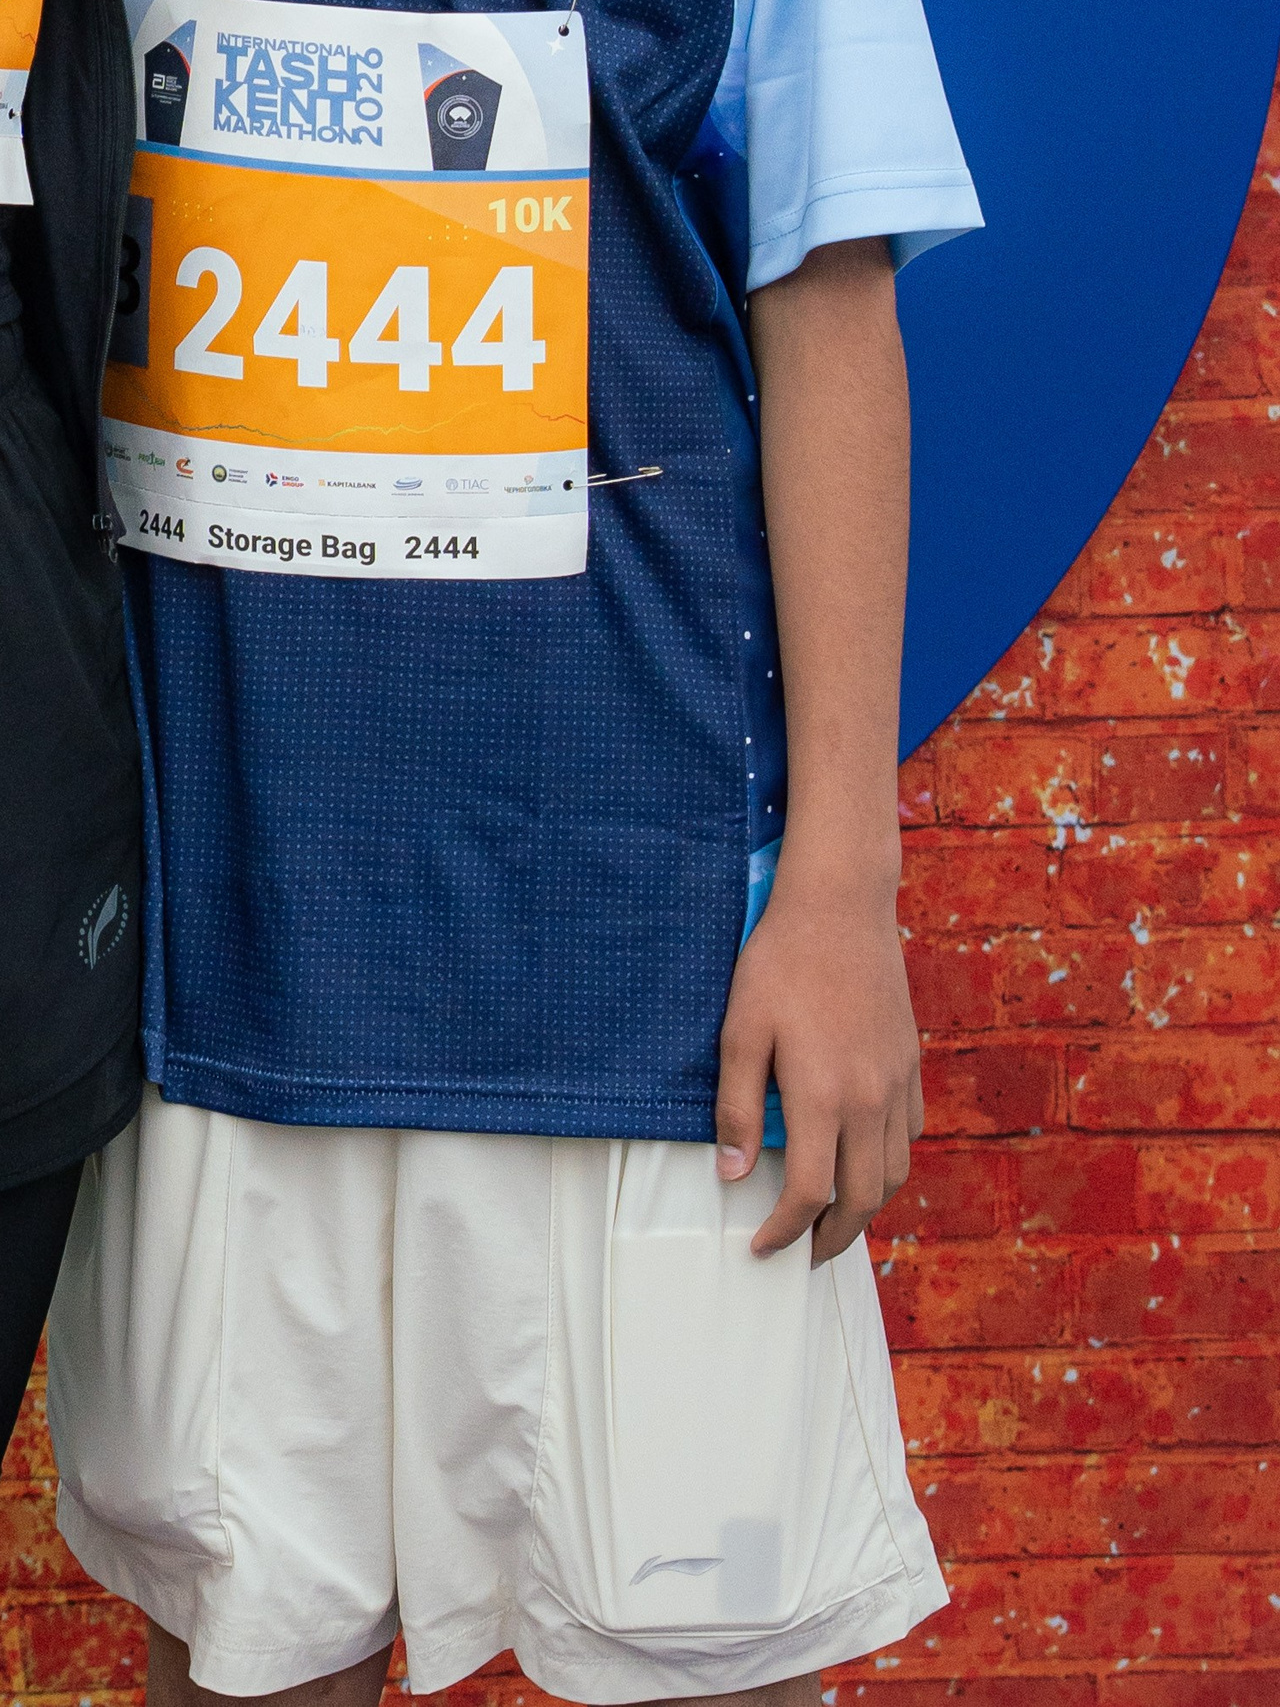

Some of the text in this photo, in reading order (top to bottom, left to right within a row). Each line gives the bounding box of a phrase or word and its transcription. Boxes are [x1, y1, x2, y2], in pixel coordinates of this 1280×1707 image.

[217, 32, 354, 57] INTERNATIONAL
[217, 45, 357, 101] TASH
[215, 78, 357, 127] KENT
[354, 48, 383, 147] 2026
[213, 114, 360, 145] MARATHON
[487, 196, 573, 233] 10K
[174, 246, 546, 392] 2444
[327, 481, 376, 489] KAPITALBANK
[460, 478, 490, 490] TIAC
[139, 509, 479, 565] 2444 Storage Bag 2444
